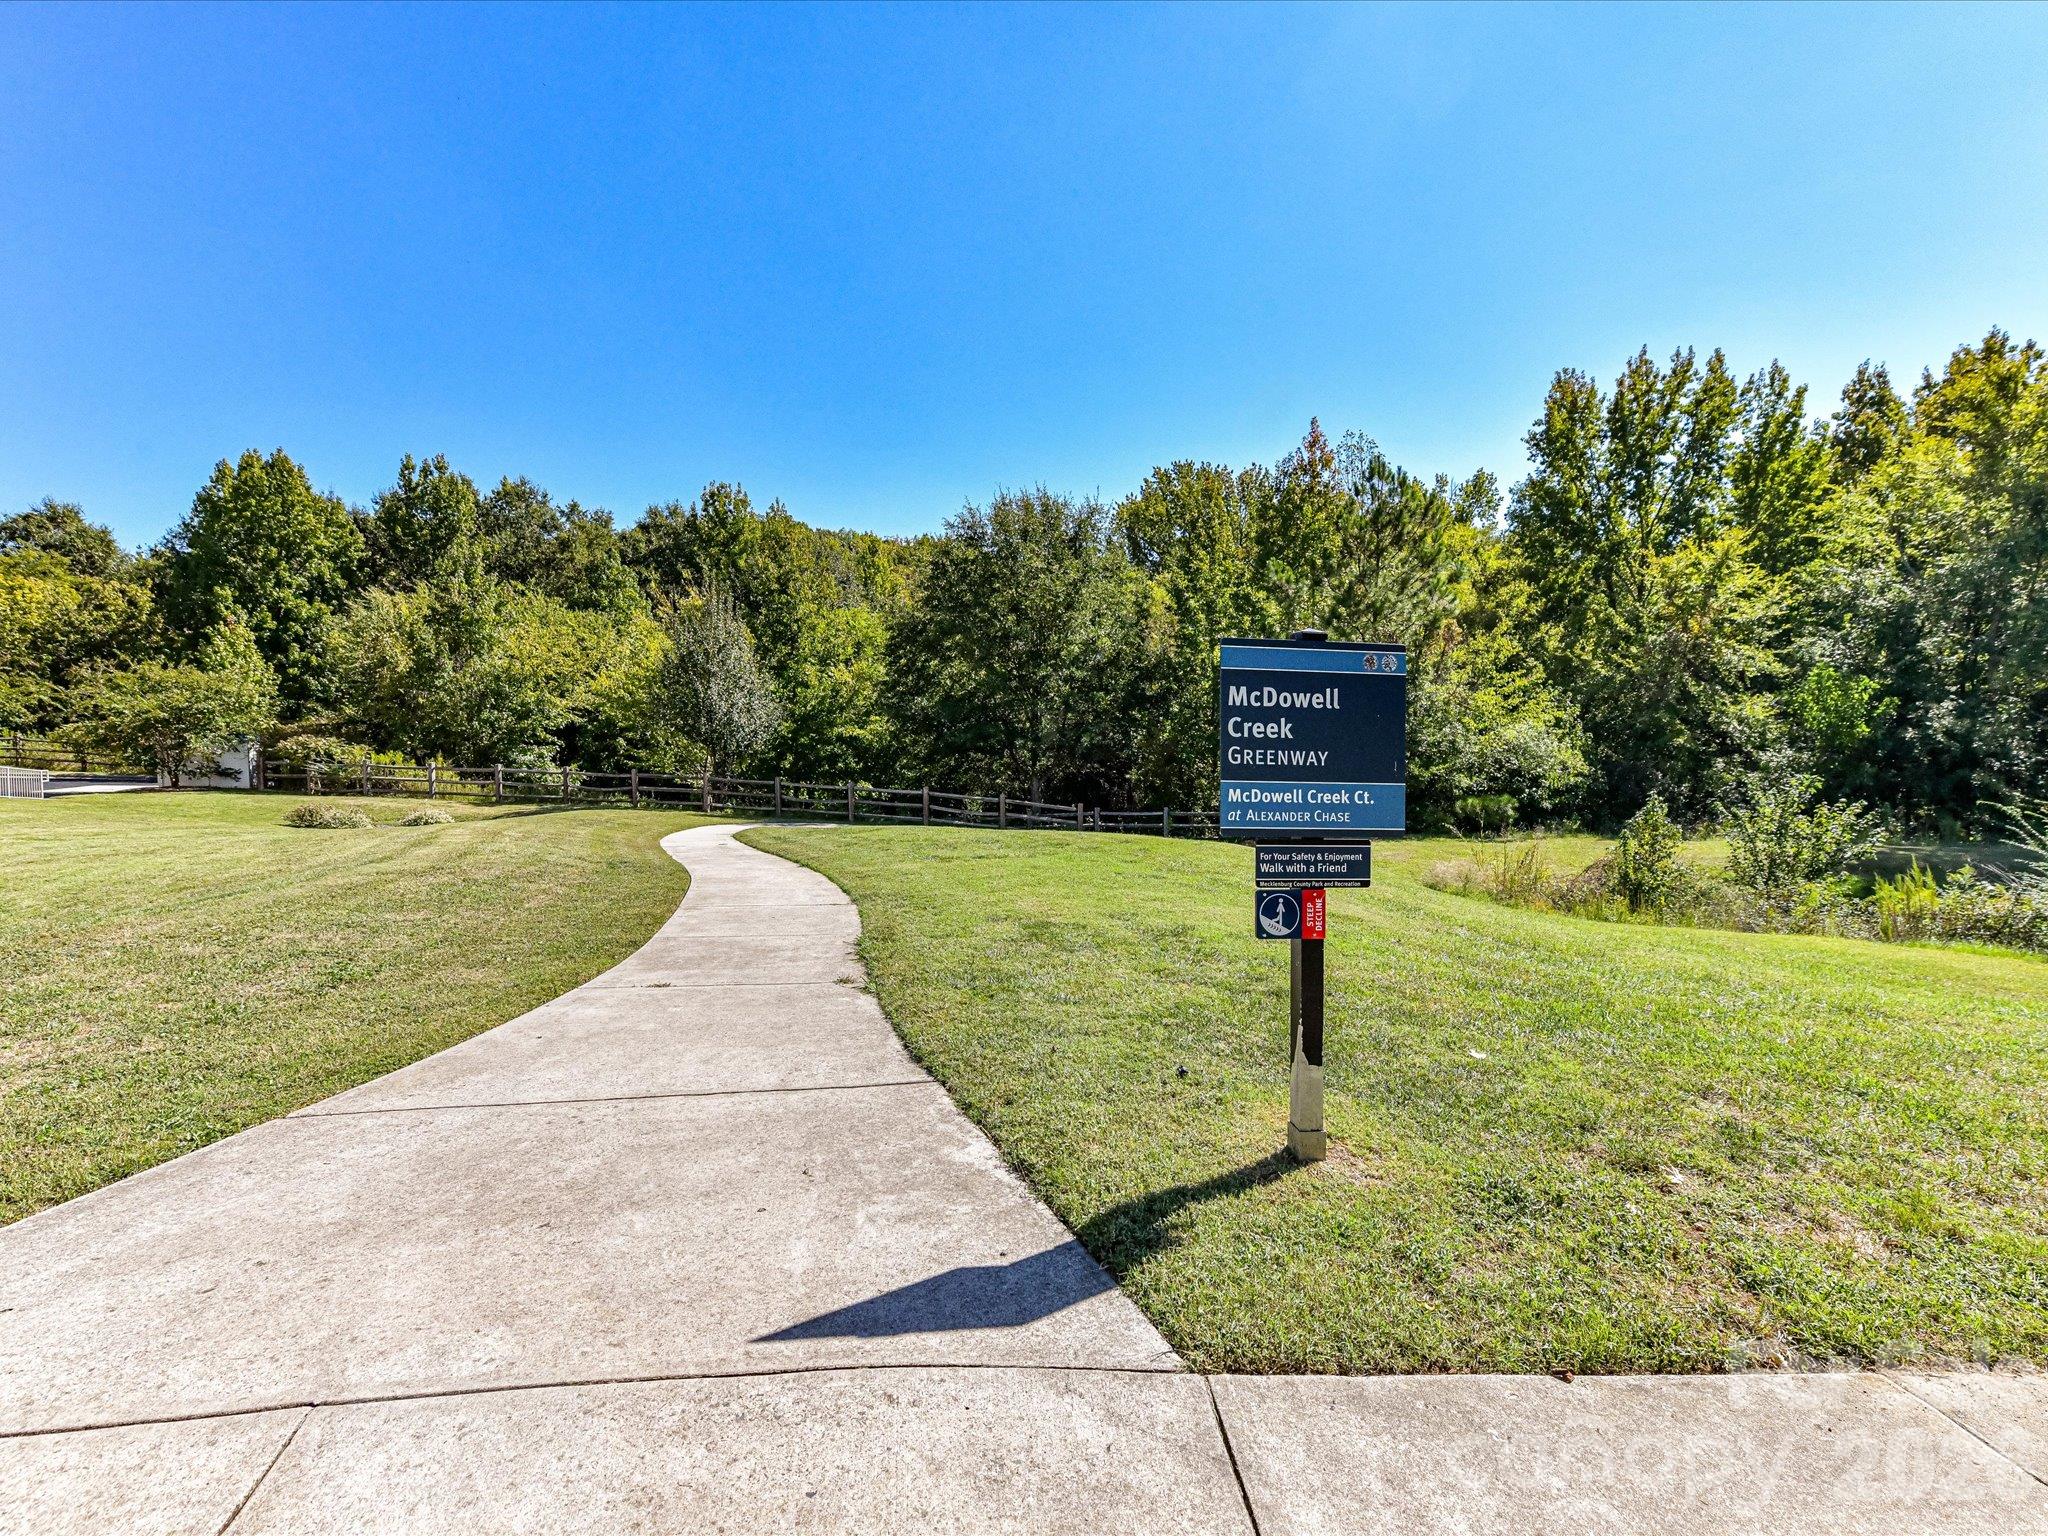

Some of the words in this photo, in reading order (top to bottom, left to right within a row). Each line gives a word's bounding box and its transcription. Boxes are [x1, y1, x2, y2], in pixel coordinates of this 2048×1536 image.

[1228, 685, 1340, 709] McDowell
[1227, 716, 1294, 739] Creek
[1227, 746, 1329, 766] GREENWAY
[1228, 788, 1303, 804] McDowell
[1307, 789, 1350, 804] Creek
[1354, 790, 1375, 805] Ct.
[1227, 809, 1242, 821] at
[1246, 809, 1311, 822] ALEXANDER
[1314, 810, 1351, 822] CHASE
[1260, 852, 1272, 861] For
[1273, 852, 1290, 861] Your
[1291, 852, 1316, 862] Safety
[1316, 853, 1323, 861] &
[1324, 852, 1363, 862] Enjoyment
[1260, 863, 1284, 873] Walk
[1285, 863, 1307, 873] with
[1309, 865, 1315, 873] a
[1317, 863, 1347, 873] Friend
[1306, 902, 1314, 927] STEEP
[1315, 898, 1323, 931] DECLINE
